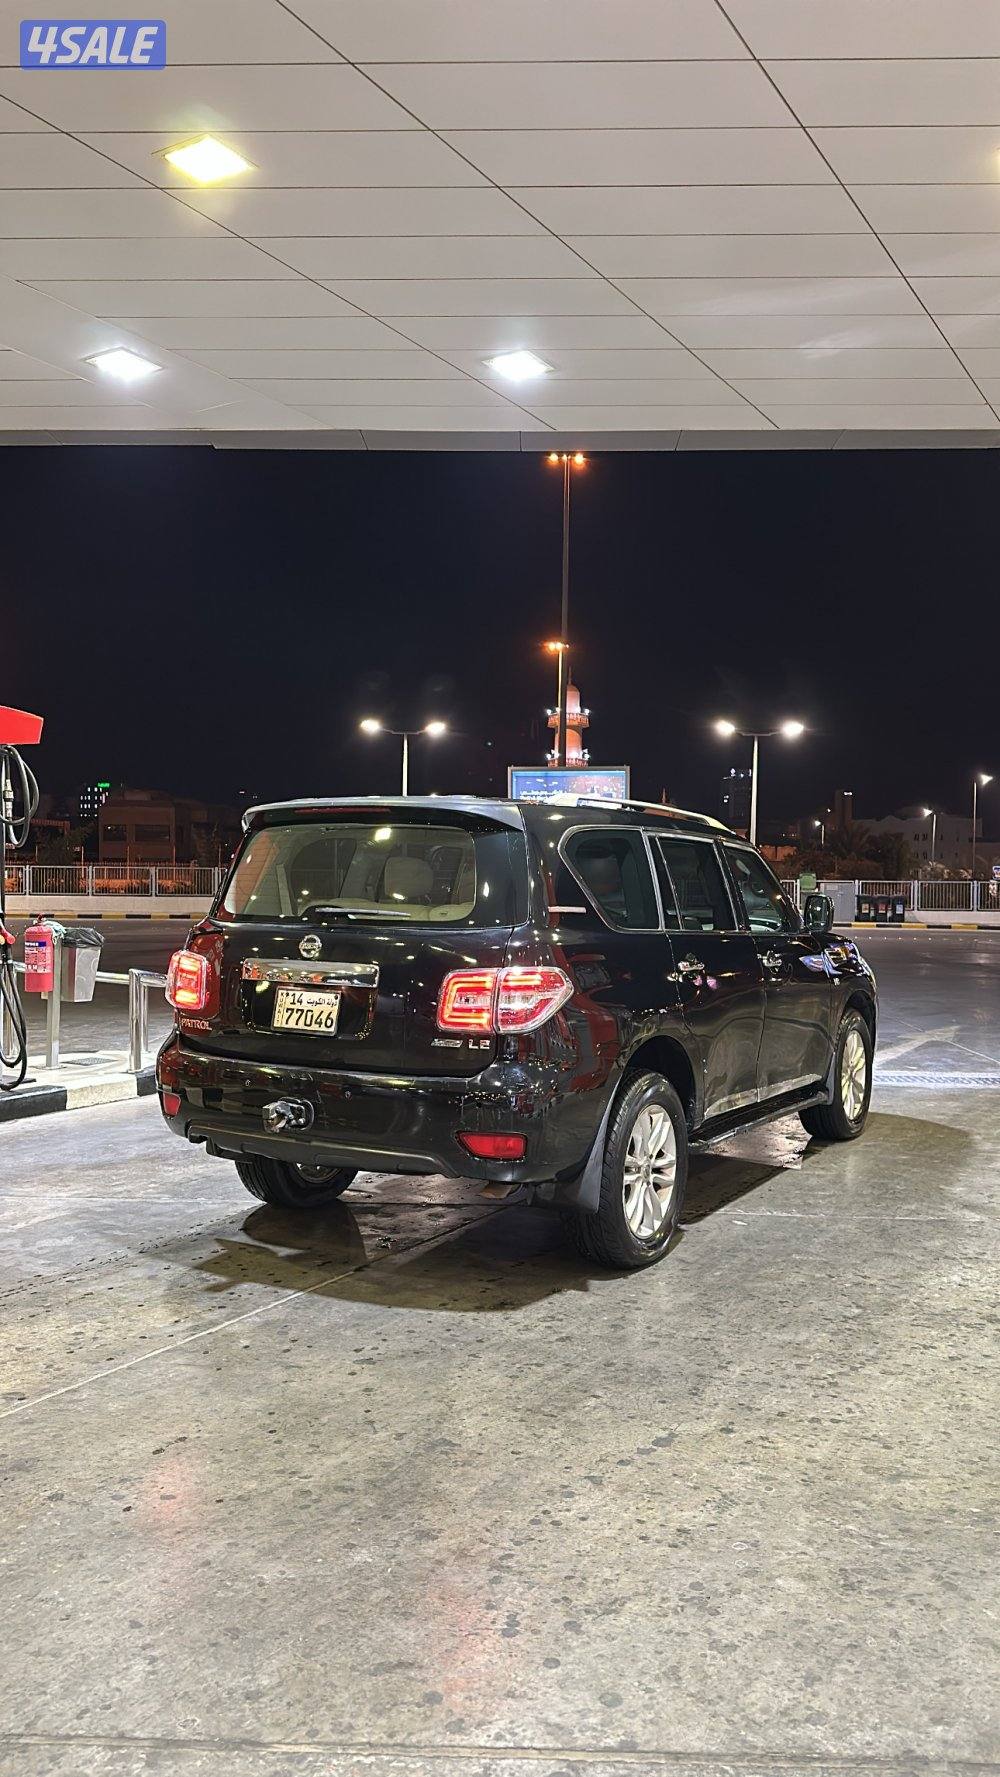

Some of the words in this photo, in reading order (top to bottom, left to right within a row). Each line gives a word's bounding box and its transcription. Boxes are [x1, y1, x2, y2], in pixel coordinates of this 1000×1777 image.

[290, 993, 303, 1005] 14
[181, 1018, 212, 1030] PATROL
[285, 1008, 334, 1028] 77046
